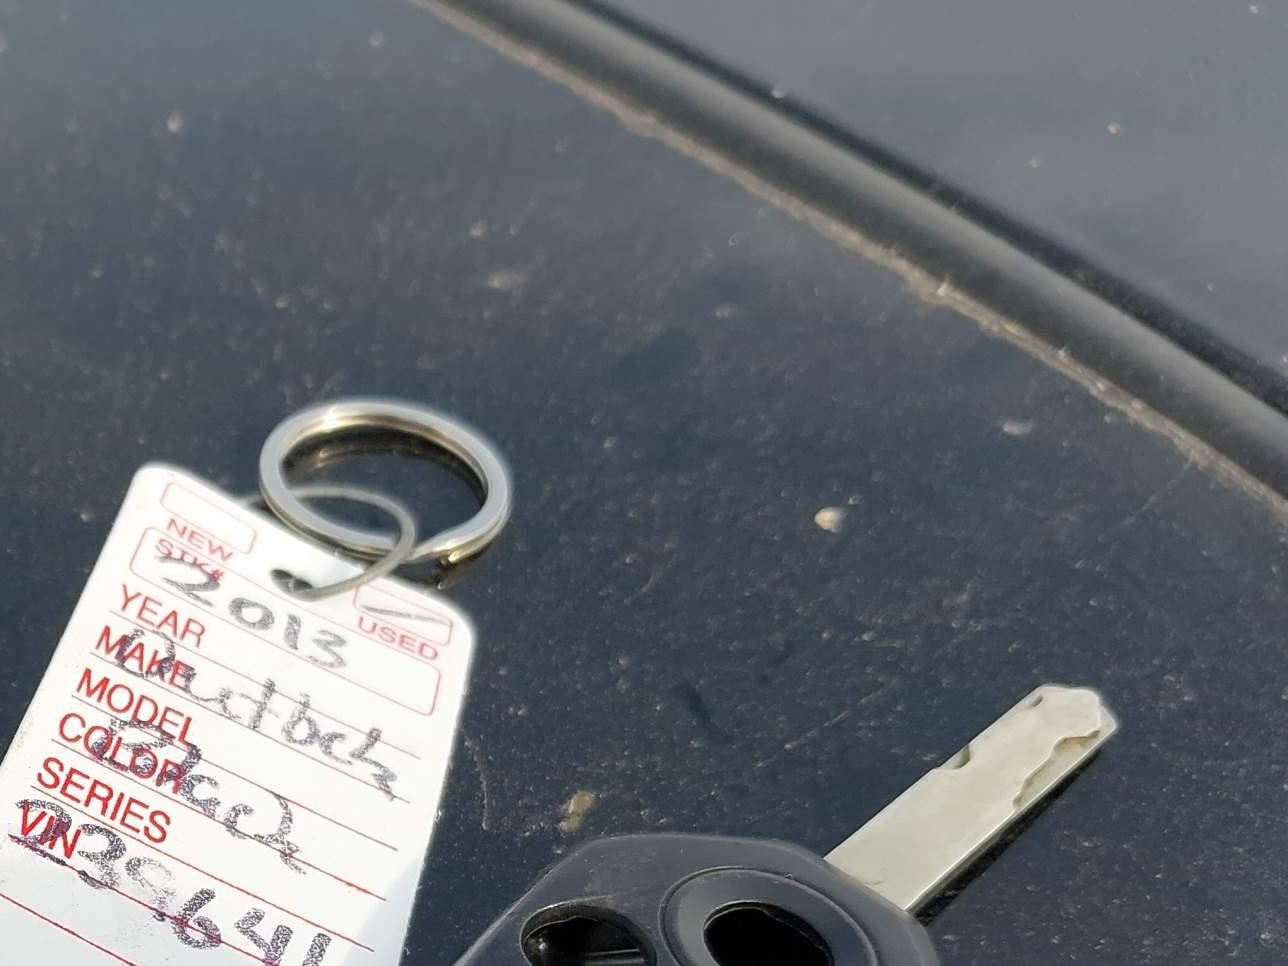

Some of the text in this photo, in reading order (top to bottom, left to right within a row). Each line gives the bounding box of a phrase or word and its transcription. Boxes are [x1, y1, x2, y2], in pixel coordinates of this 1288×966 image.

[155, 538, 225, 583] STK#
[166, 517, 234, 562] NEW
[120, 583, 206, 649] YEAR
[154, 554, 348, 669] 2013
[355, 616, 440, 662] USED
[95, 624, 197, 688] MAKE
[76, 667, 199, 749] MODEL
[57, 712, 186, 795] COLOR
[18, 803, 83, 860] VIN
[36, 756, 172, 844] SERIES
